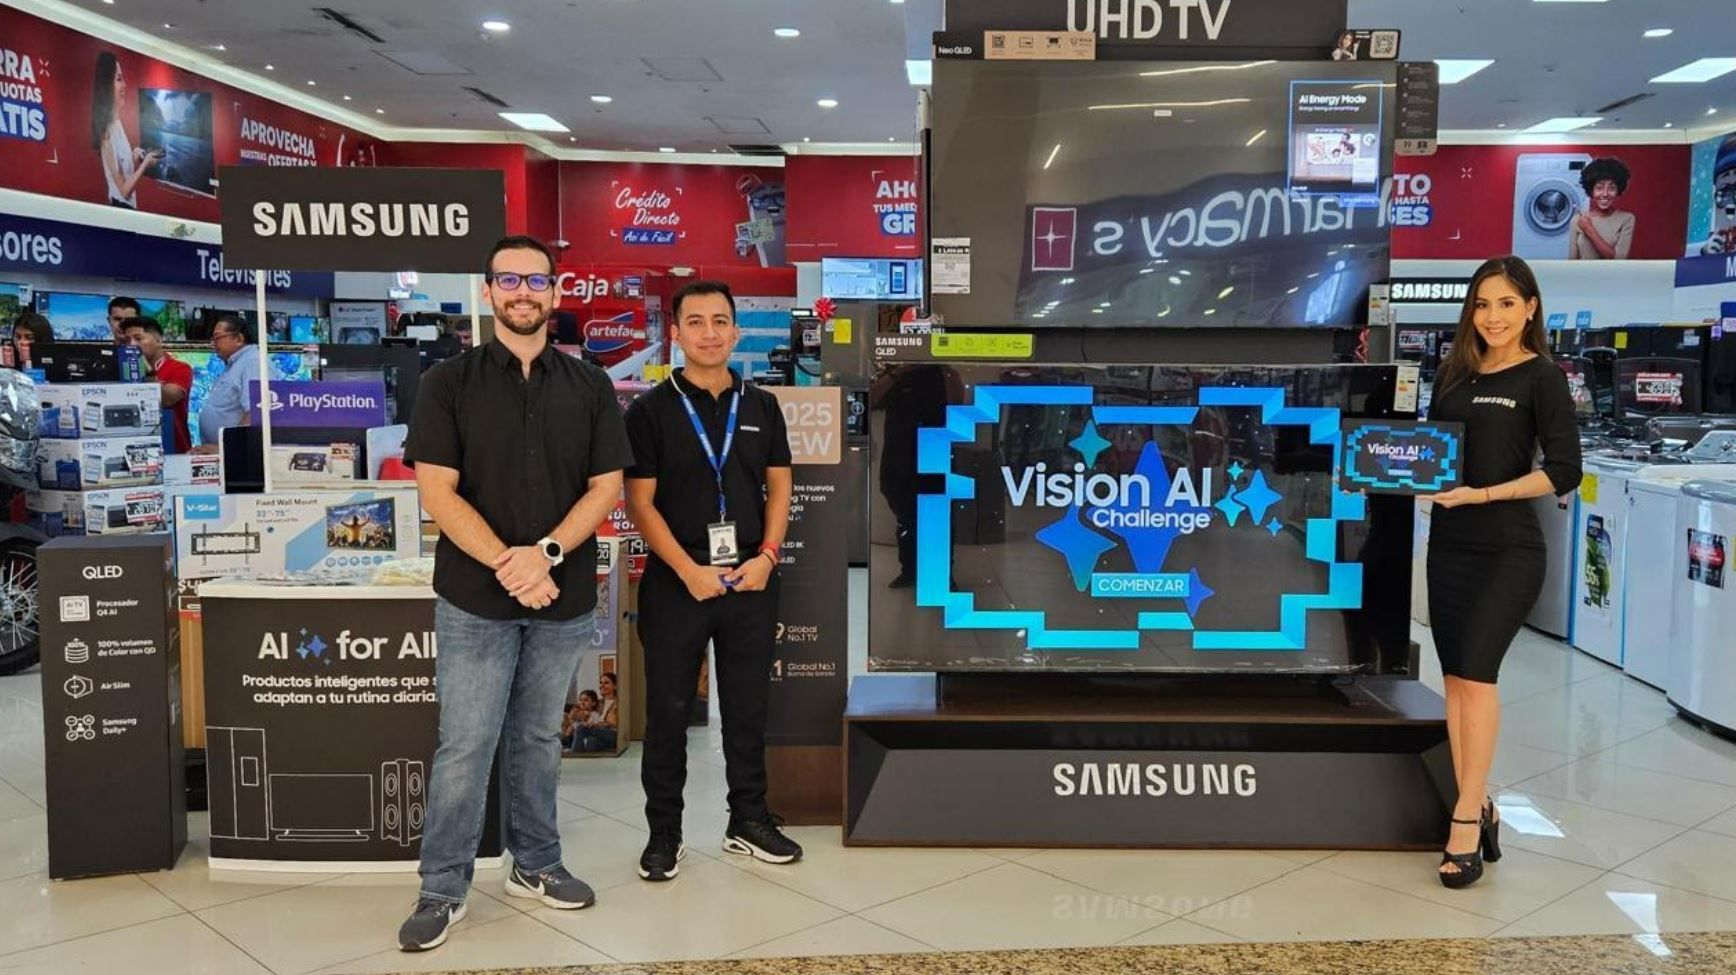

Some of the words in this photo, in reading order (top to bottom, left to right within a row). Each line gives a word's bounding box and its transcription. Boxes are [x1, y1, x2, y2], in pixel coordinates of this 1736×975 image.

[1067, 0, 1163, 39] UHD
[1169, 0, 1232, 40] TV
[0, 48, 36, 84] RA
[1309, 95, 1340, 105] Energy
[1341, 95, 1367, 104] Mode
[240, 117, 316, 159] APROVECHA
[876, 181, 916, 198] AH
[615, 187, 671, 209] Crédito
[1395, 196, 1430, 205] HASTA
[873, 204, 893, 213] TUS
[253, 202, 470, 238] SAMSUNG
[633, 208, 680, 226] Directo
[0, 230, 63, 265] ores
[197, 249, 292, 288] Televisres
[560, 272, 609, 304] Caja
[875, 337, 922, 346] SAMSUNG
[875, 347, 897, 356] QLED
[82, 388, 107, 396] EPSON
[289, 394, 376, 412] PlayStation
[1473, 396, 1517, 408] SAMSUNG
[790, 431, 833, 456] EW
[1368, 443, 1404, 455] Vision
[1406, 445, 1419, 455] AI
[1001, 463, 1150, 508] Vision
[1165, 467, 1212, 507] AI
[294, 498, 318, 506] Mount
[1092, 507, 1211, 534] Challenge
[82, 566, 123, 580] QLED
[1098, 577, 1185, 593] COMENZAR
[120, 639, 153, 647] volumen
[258, 633, 288, 660] AI
[336, 630, 388, 660] for
[398, 632, 438, 660] All
[109, 648, 128, 656] Color
[113, 682, 130, 690] Slim
[242, 675, 312, 688] Productos
[315, 675, 398, 690] inteligentes
[401, 678, 429, 690] que
[253, 692, 313, 707] adaptan
[316, 694, 326, 703] a
[330, 692, 343, 703] tu
[347, 691, 390, 703] rutina
[102, 717, 137, 727] Samsung
[103, 727, 127, 735] Daily+
[1053, 763, 1257, 796] SAMSUNG
